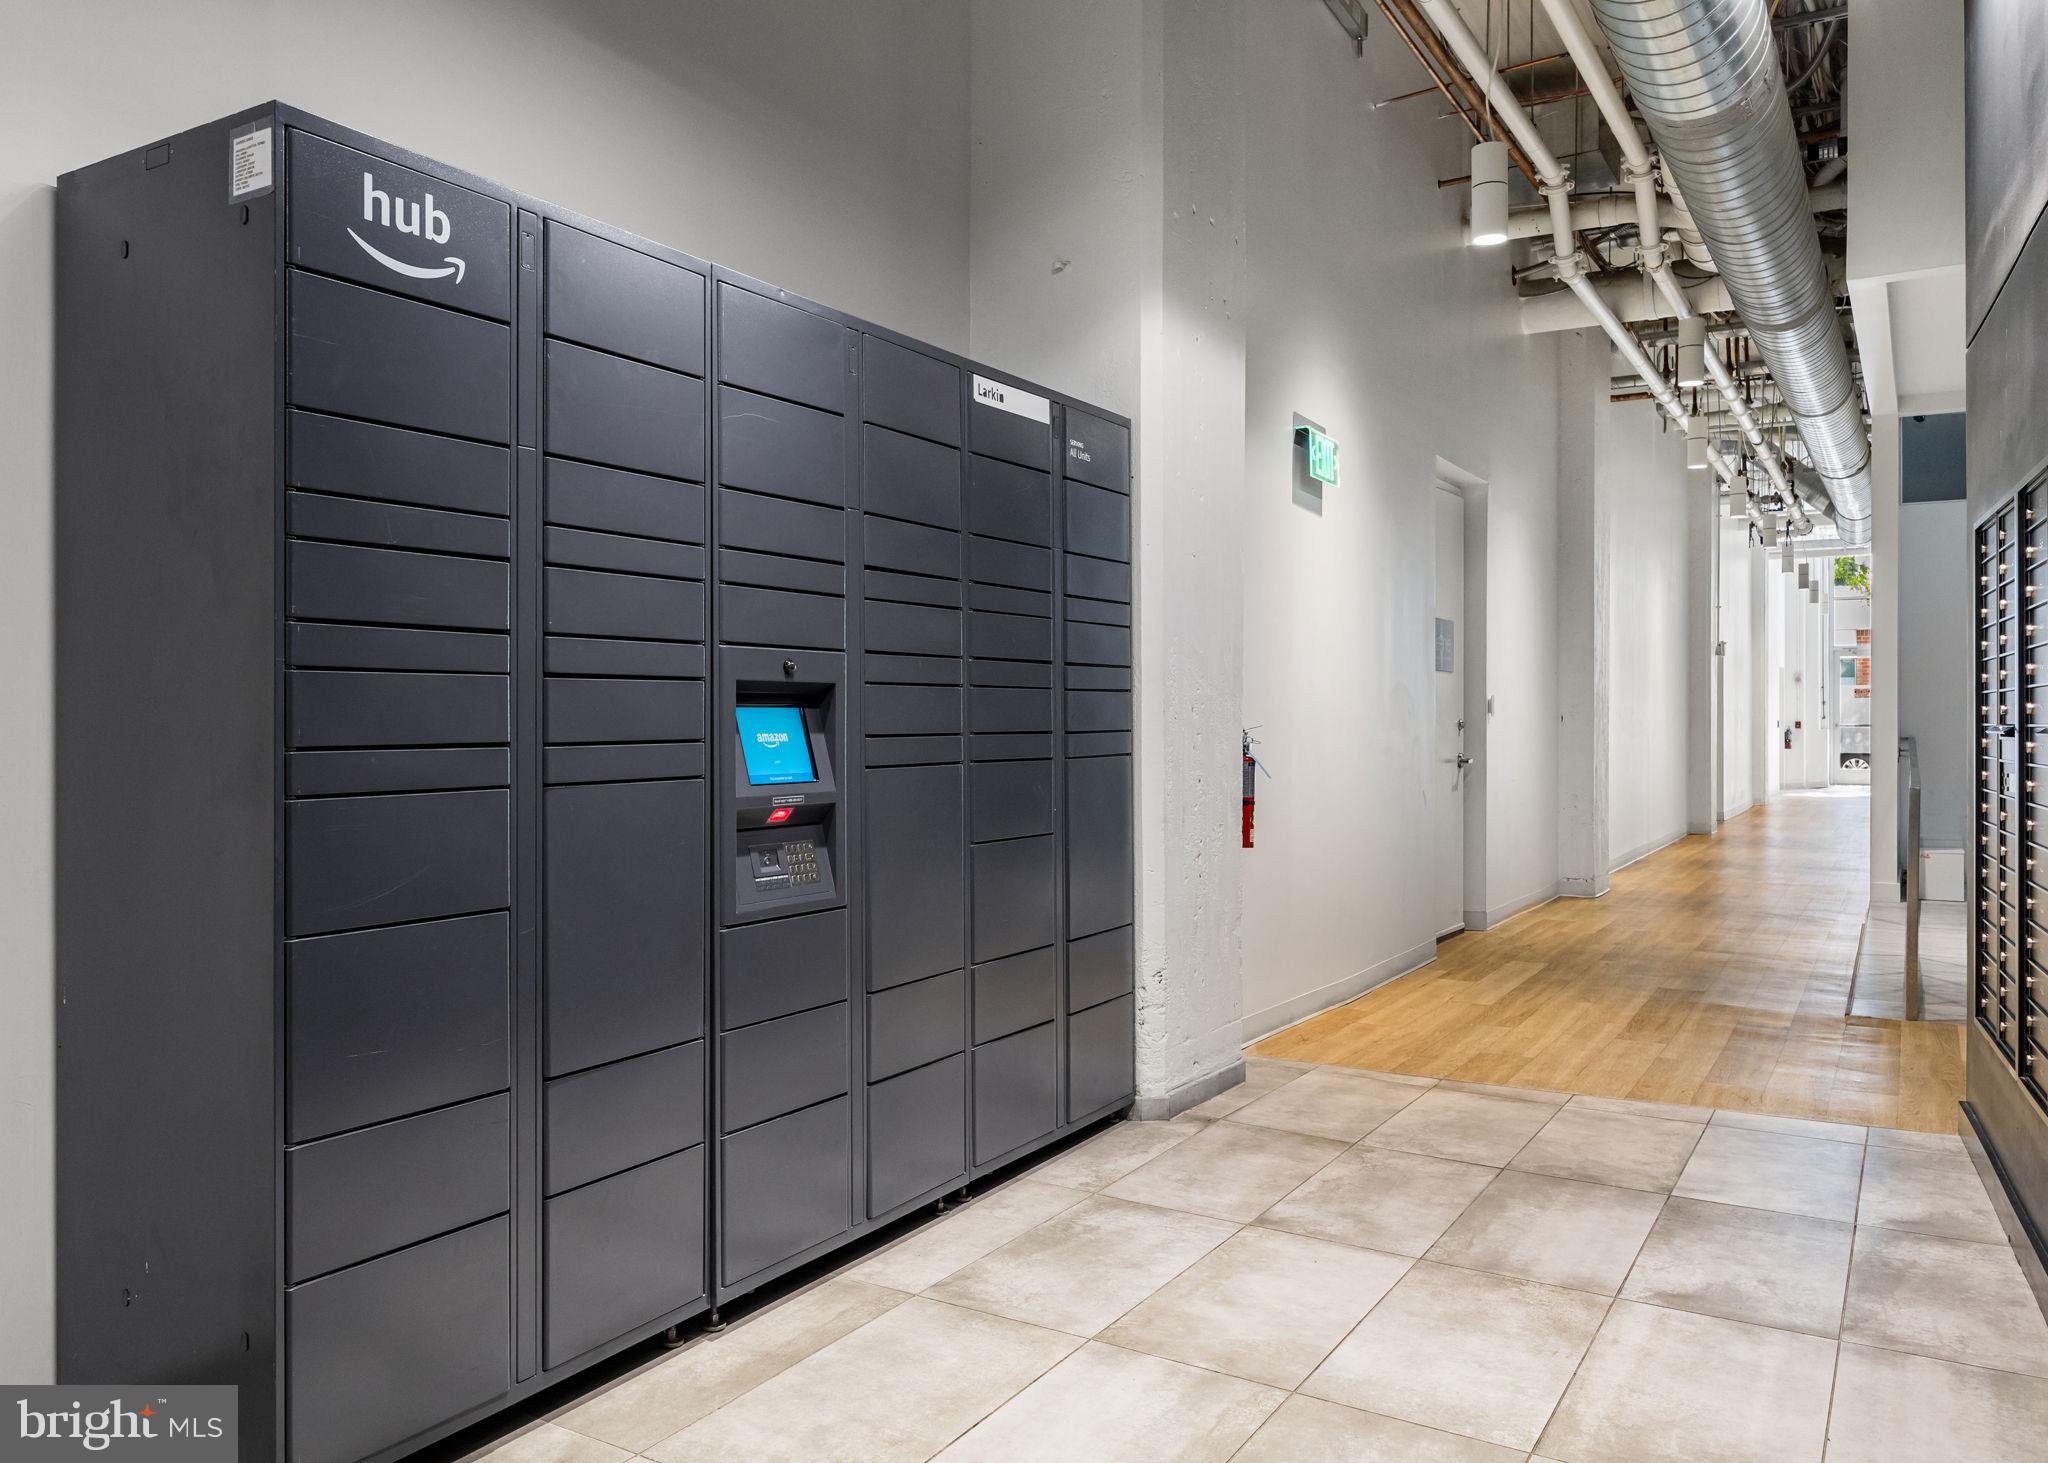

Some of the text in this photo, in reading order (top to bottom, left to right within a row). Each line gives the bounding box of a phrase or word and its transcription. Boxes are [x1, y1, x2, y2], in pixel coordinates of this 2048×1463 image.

[363, 172, 451, 245] hub
[977, 383, 1004, 403] Larkin
[1078, 450, 1090, 462] Units
[757, 733, 788, 742] amazon
